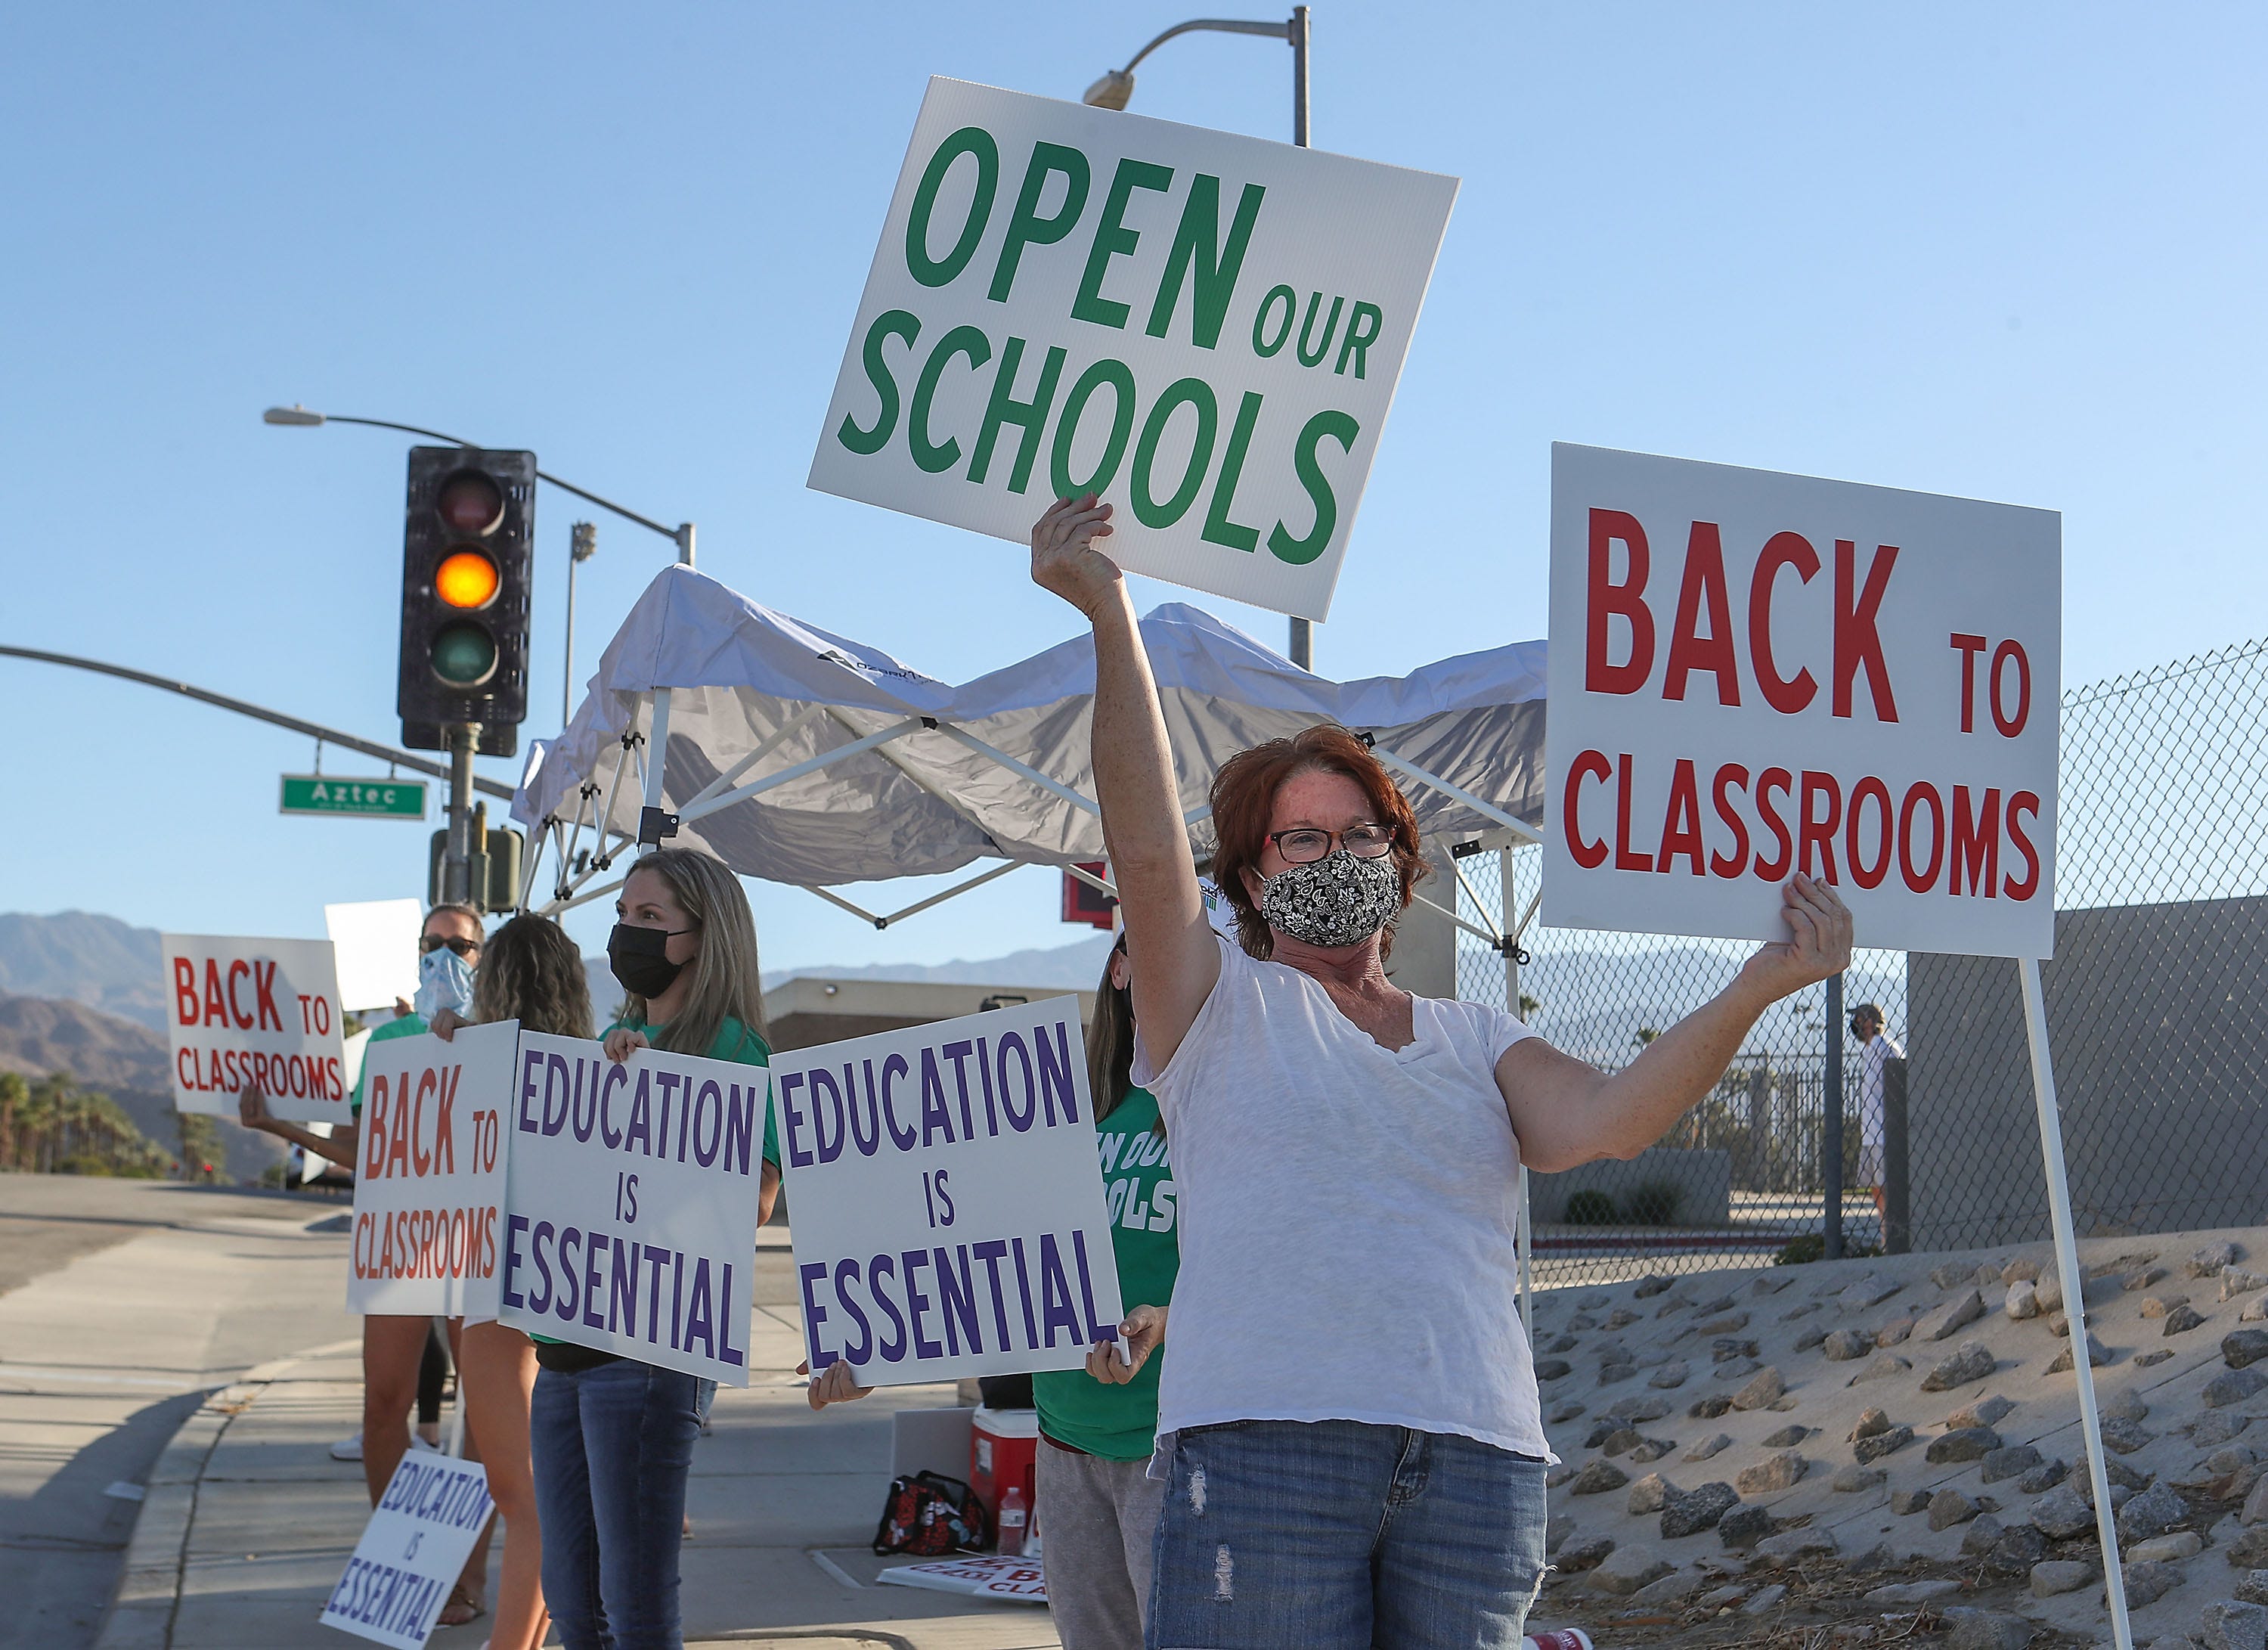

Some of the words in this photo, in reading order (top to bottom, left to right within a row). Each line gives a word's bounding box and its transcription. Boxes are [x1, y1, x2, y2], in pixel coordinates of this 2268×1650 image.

[906, 126, 1266, 350] OPEN
[1253, 284, 1383, 380] OUR
[838, 309, 1360, 565] SCHOOLS
[1585, 507, 1900, 723] BACK
[1951, 633, 2031, 738] TO
[311, 782, 396, 805] Aztec
[1563, 749, 2040, 902] CLASSROOMS
[174, 957, 283, 1031] BACK
[298, 995, 330, 1036] TO
[178, 1047, 343, 1102] CLASSROOMS
[365, 1064, 461, 1180] BACK
[472, 1109, 499, 1174] TO
[519, 1049, 756, 1176] EDUCATION
[780, 1021, 1080, 1169] EDUCATION
[355, 1205, 497, 1280] CLASSROOMS
[615, 1171, 639, 1224] IS
[922, 1168, 955, 1229] IS
[502, 1214, 744, 1367] ESSENTIAL
[799, 1230, 1119, 1370] ESSENTIAL
[381, 1460, 492, 1531] EDUCATION
[402, 1531, 426, 1562] IS
[327, 1557, 445, 1642] ESSENTIAL
